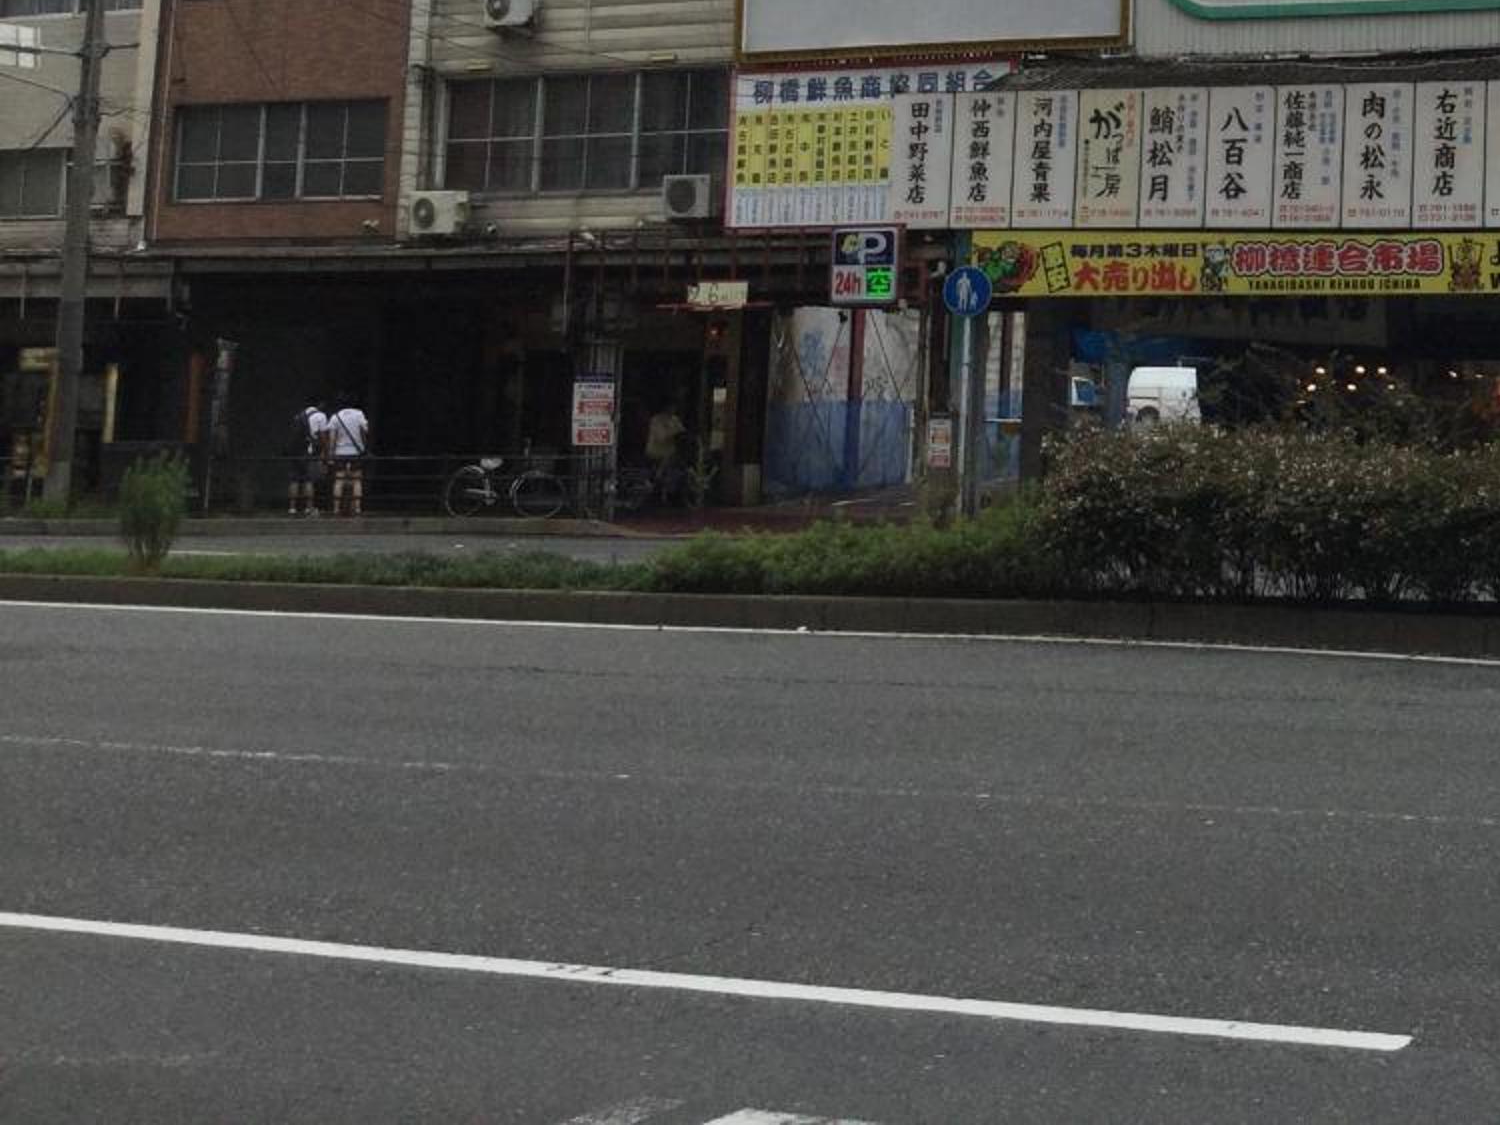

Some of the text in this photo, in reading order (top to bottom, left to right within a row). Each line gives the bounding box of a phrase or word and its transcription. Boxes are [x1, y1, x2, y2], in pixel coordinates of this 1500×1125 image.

[906, 102, 930, 204] 田中野菜店
[967, 98, 991, 202] 仲西鮮魚店
[1030, 97, 1053, 203] 河内屋青果
[1219, 106, 1249, 200] 八百谷
[1359, 90, 1386, 200] 肉の松永
[1432, 83, 1458, 196] 右近商店
[836, 271, 862, 295] 24h
[1071, 242, 1198, 258] 毎月第3木曜日
[1073, 262, 1197, 292] 大売り出し
[1235, 241, 1443, 274] 柳橋連合市場
